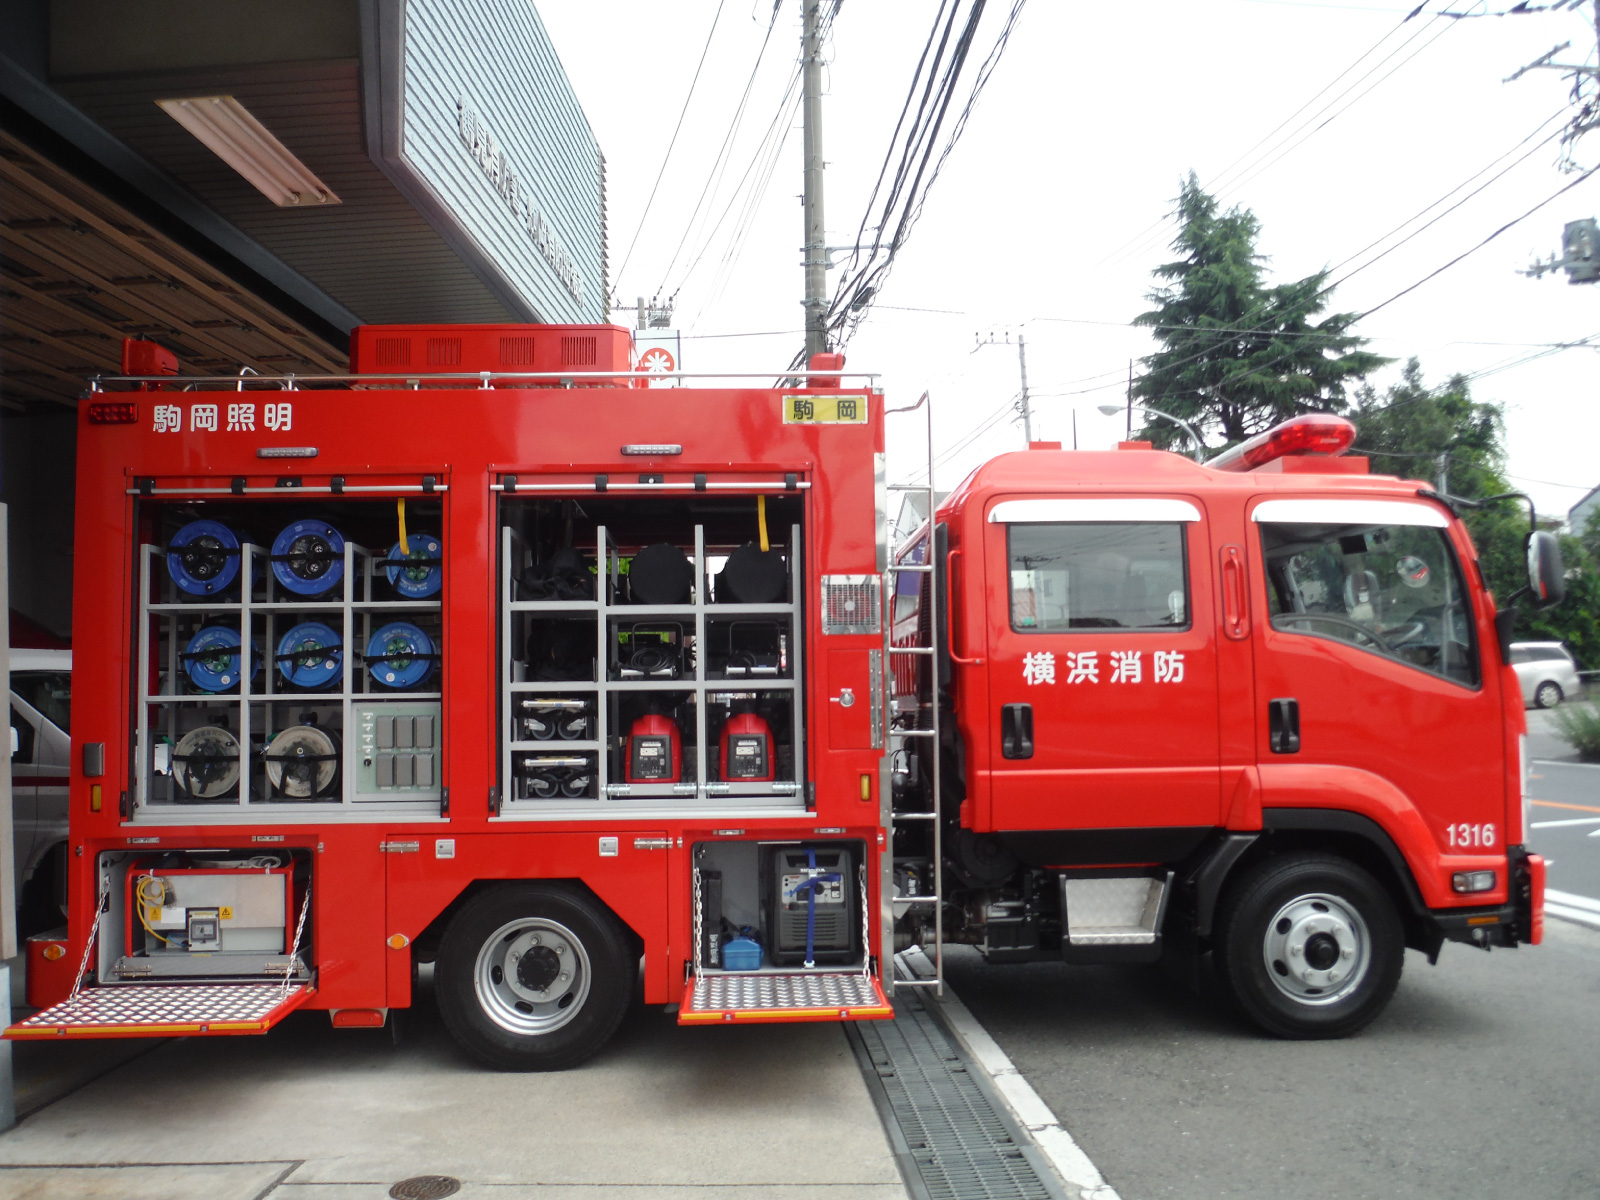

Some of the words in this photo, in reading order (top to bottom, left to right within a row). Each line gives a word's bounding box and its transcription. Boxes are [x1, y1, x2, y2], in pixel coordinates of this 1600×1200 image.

[152, 402, 292, 433] 駒岡照明
[793, 399, 857, 420] 駒岡
[1022, 650, 1185, 686] 横浜消防
[1446, 822, 1496, 847] 1316
